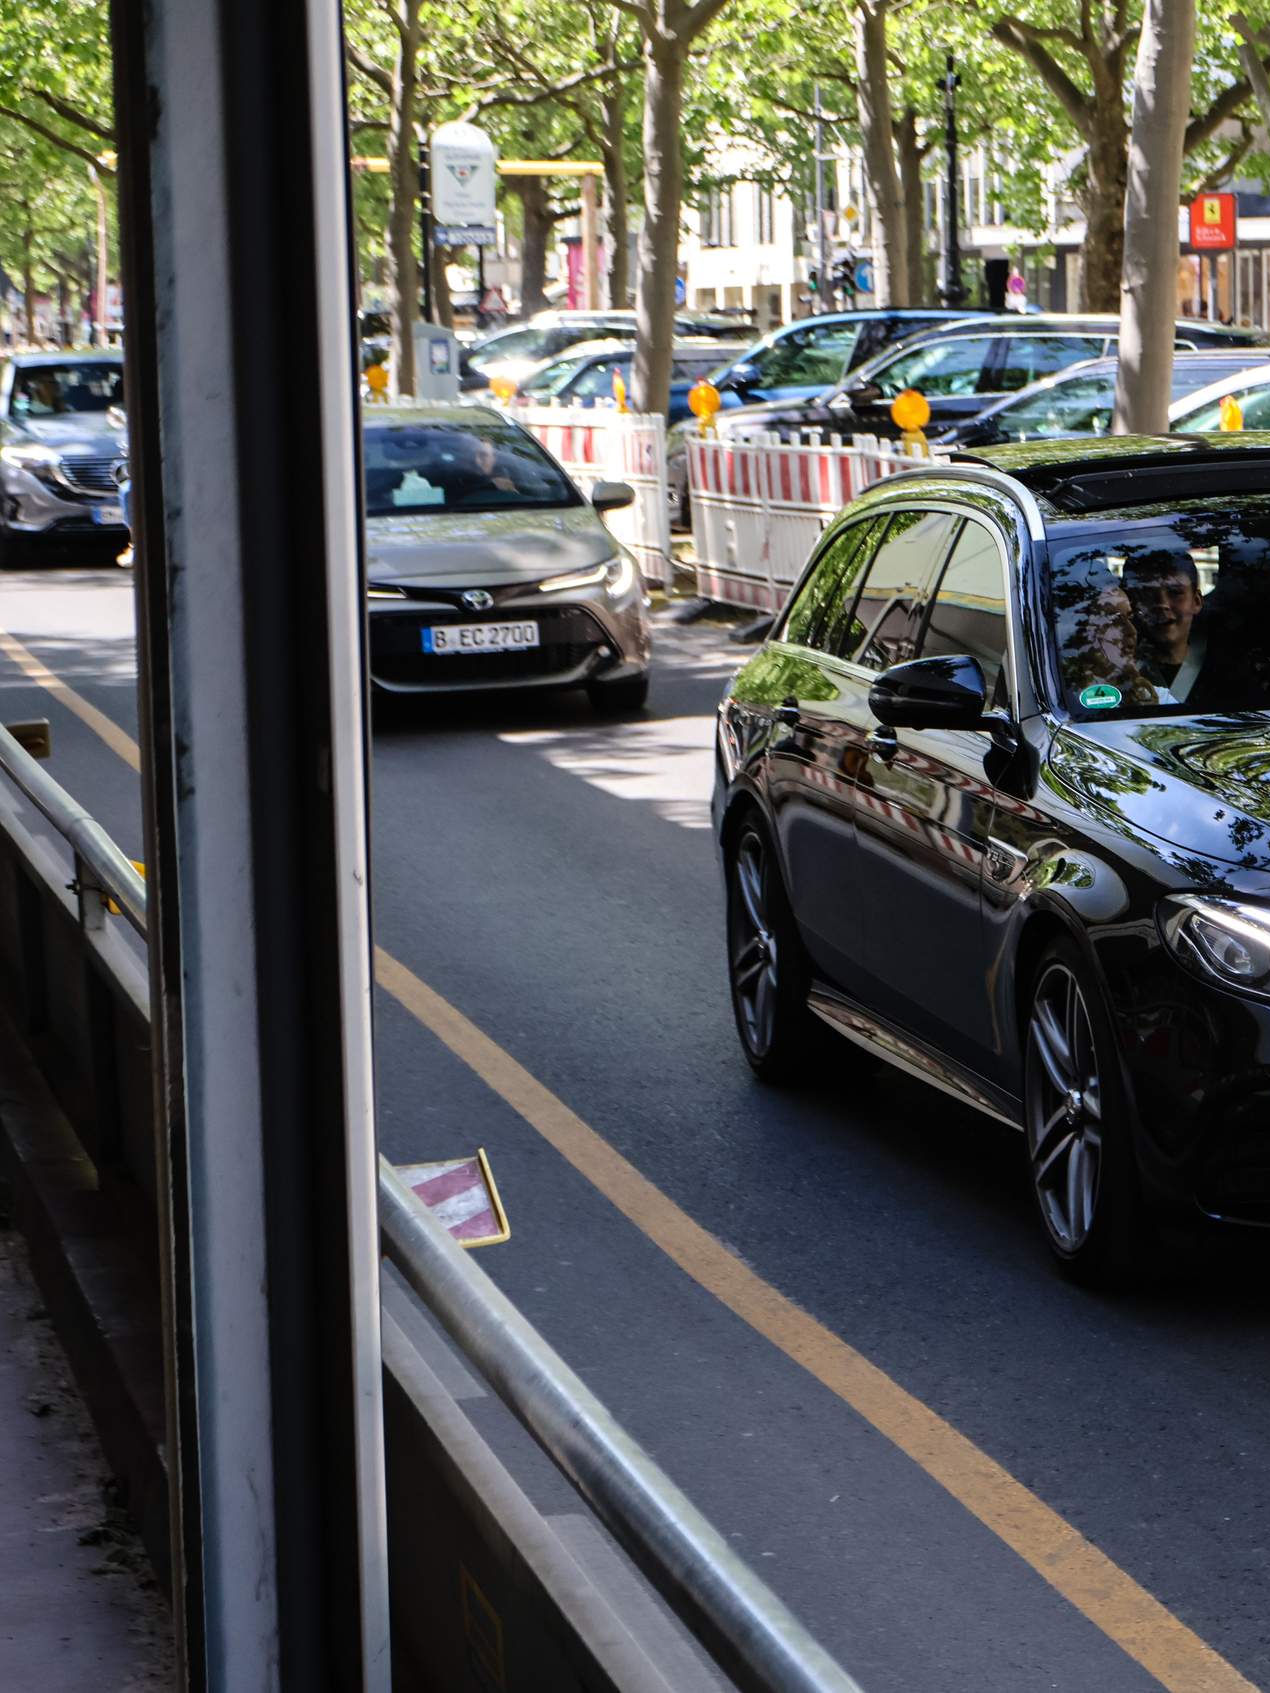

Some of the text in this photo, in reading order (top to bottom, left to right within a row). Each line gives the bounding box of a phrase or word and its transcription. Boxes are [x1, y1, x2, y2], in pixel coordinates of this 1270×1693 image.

[435, 624, 535, 649] B EC 2700
[1095, 686, 1106, 697] 4
